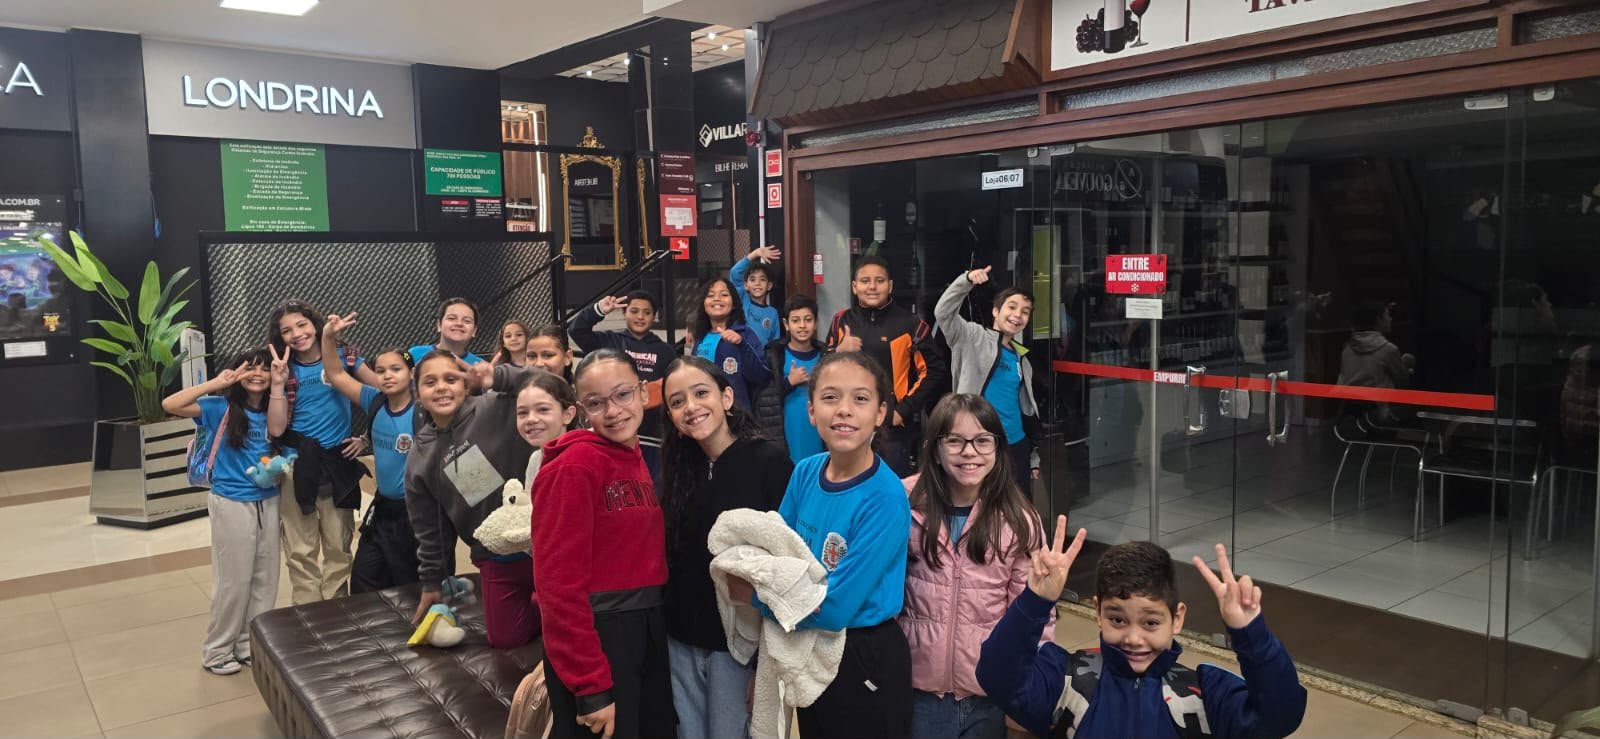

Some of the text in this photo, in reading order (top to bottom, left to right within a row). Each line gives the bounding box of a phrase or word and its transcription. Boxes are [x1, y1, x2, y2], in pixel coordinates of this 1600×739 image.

[0, 62, 44, 96] A
[182, 75, 384, 118] LONDRINA
[430, 166, 464, 174] CAPACIDADE
[1122, 257, 1150, 271] ENTRE
[1107, 271, 1164, 282] AR CONDICIONADO
